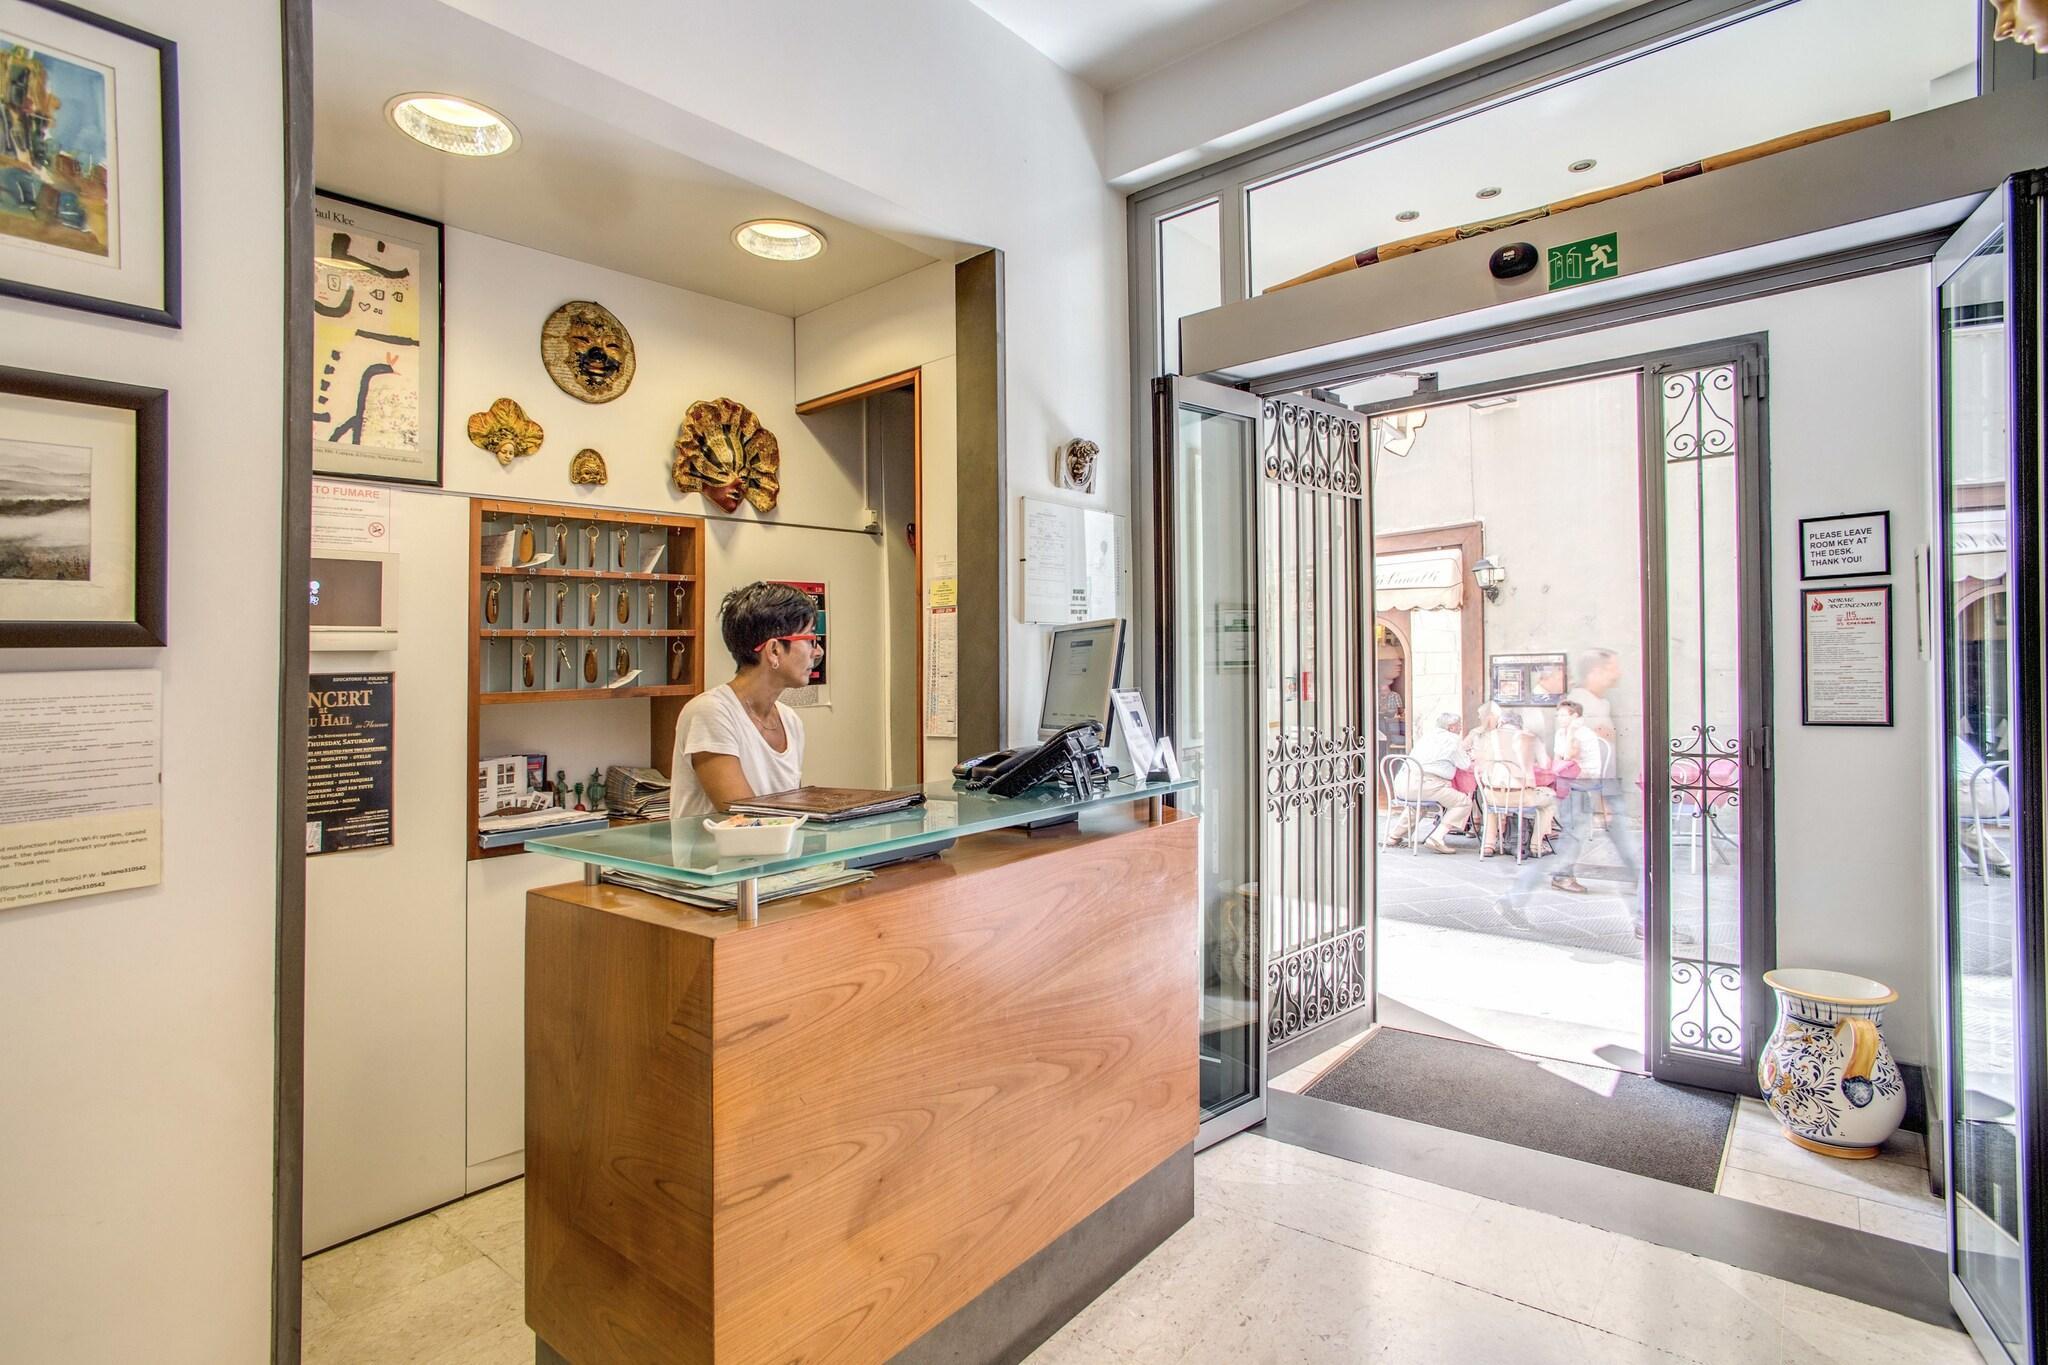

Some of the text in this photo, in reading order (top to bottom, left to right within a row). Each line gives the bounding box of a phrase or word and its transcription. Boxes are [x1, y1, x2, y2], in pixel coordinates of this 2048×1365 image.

[334, 212, 354, 226] Klee
[313, 485, 380, 499] TO FUMARE
[1810, 527, 1872, 540] PLEASE LEAVE
[1810, 537, 1868, 549] ROOM KEY AT
[1811, 548, 1854, 558] THE DESK.
[1811, 556, 1862, 567] THANK YOU!
[308, 690, 373, 708] NCERT
[101, 865, 147, 876] luciano310542
[58, 882, 106, 894] luciano310542
